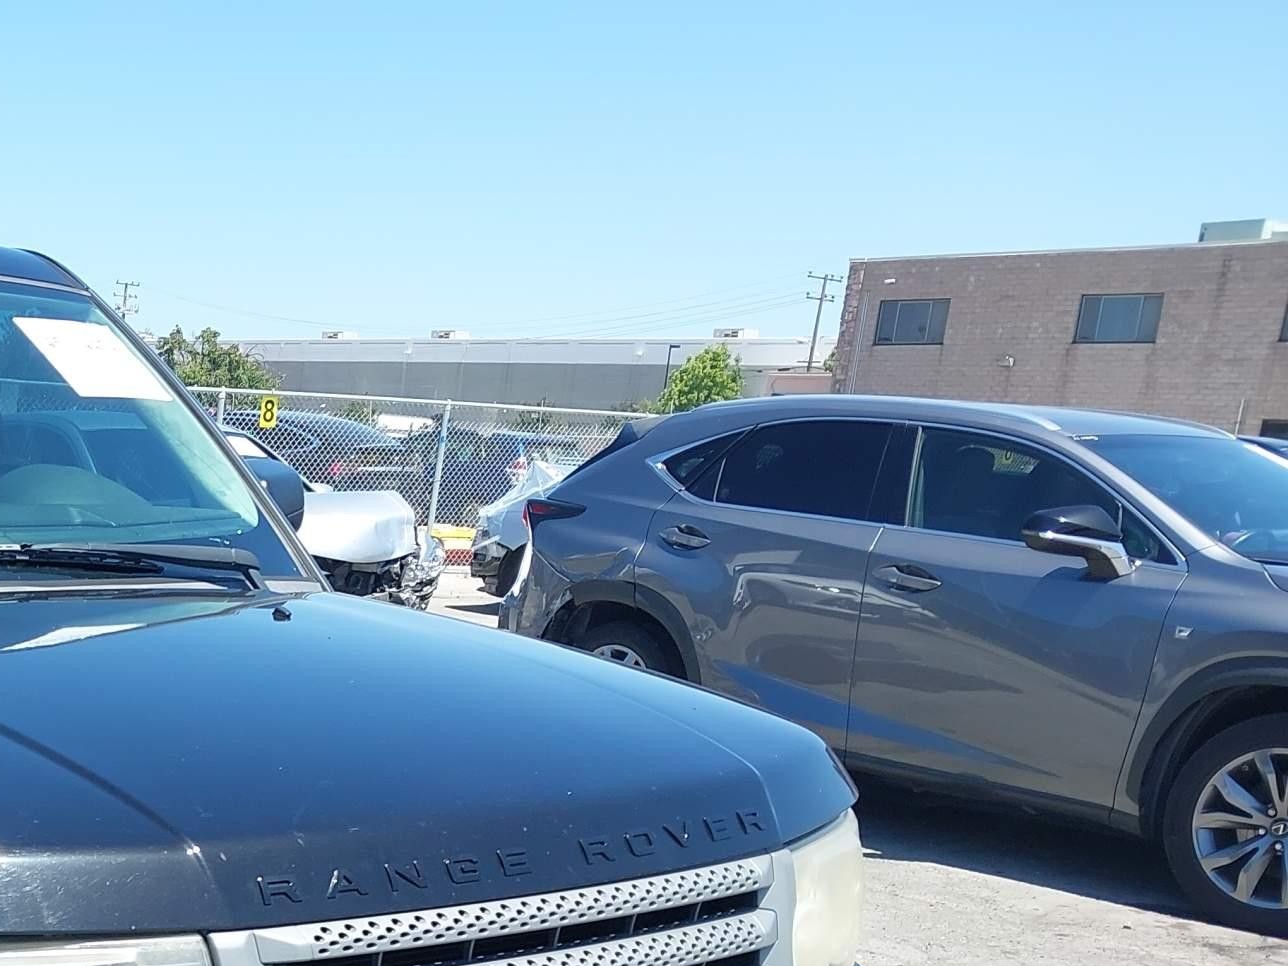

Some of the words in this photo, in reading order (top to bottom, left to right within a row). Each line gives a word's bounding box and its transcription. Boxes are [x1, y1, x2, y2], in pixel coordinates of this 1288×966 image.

[263, 400, 275, 422] 8
[257, 850, 532, 905] RANGE
[578, 811, 766, 865] ROVER
